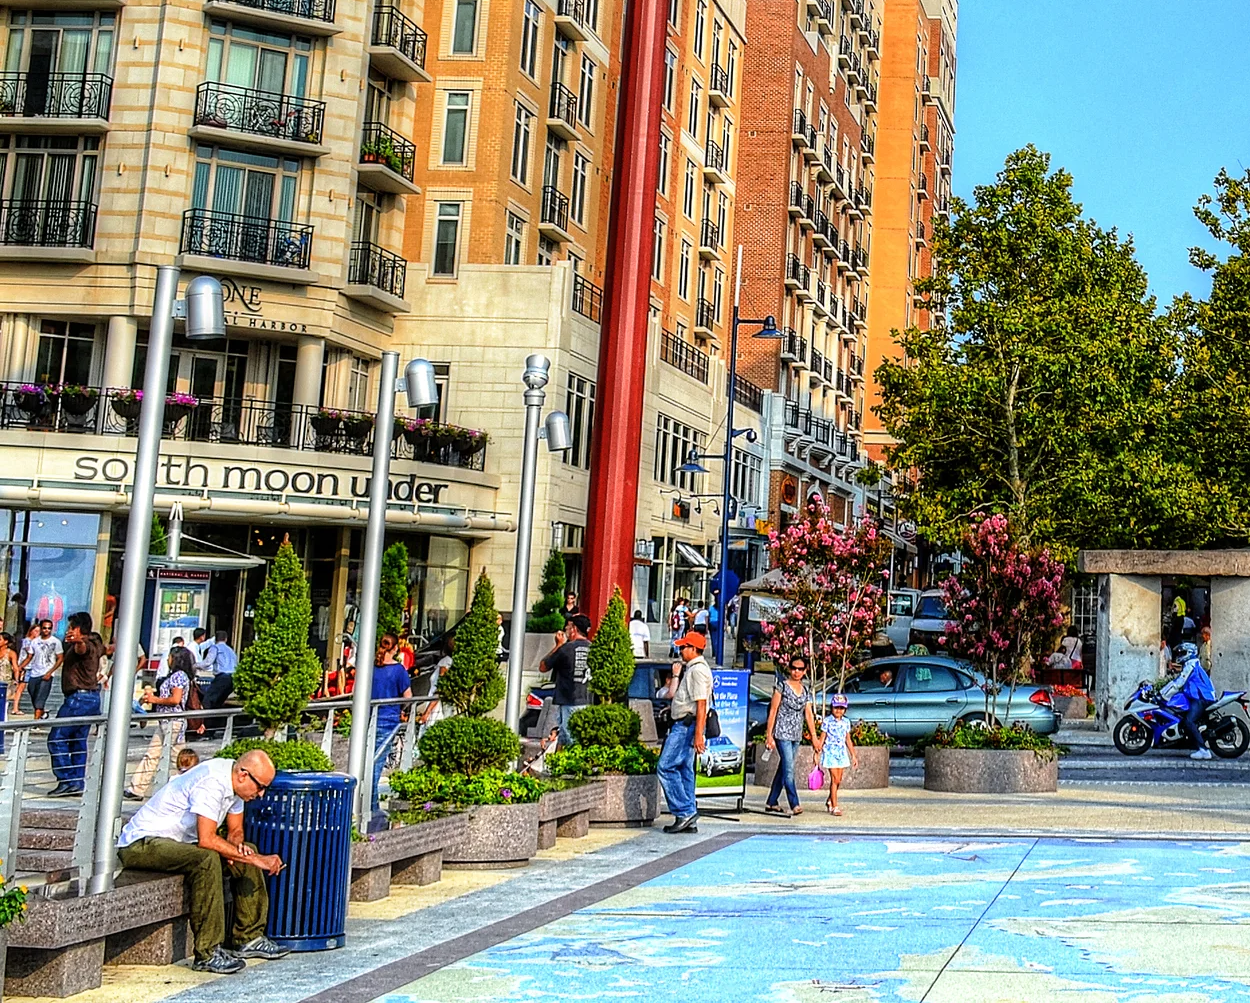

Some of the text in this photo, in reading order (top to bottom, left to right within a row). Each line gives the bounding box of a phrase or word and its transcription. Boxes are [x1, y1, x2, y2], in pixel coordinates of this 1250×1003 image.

[249, 318, 307, 333] HARBOR
[74, 455, 209, 487] soth
[222, 463, 339, 496] moon
